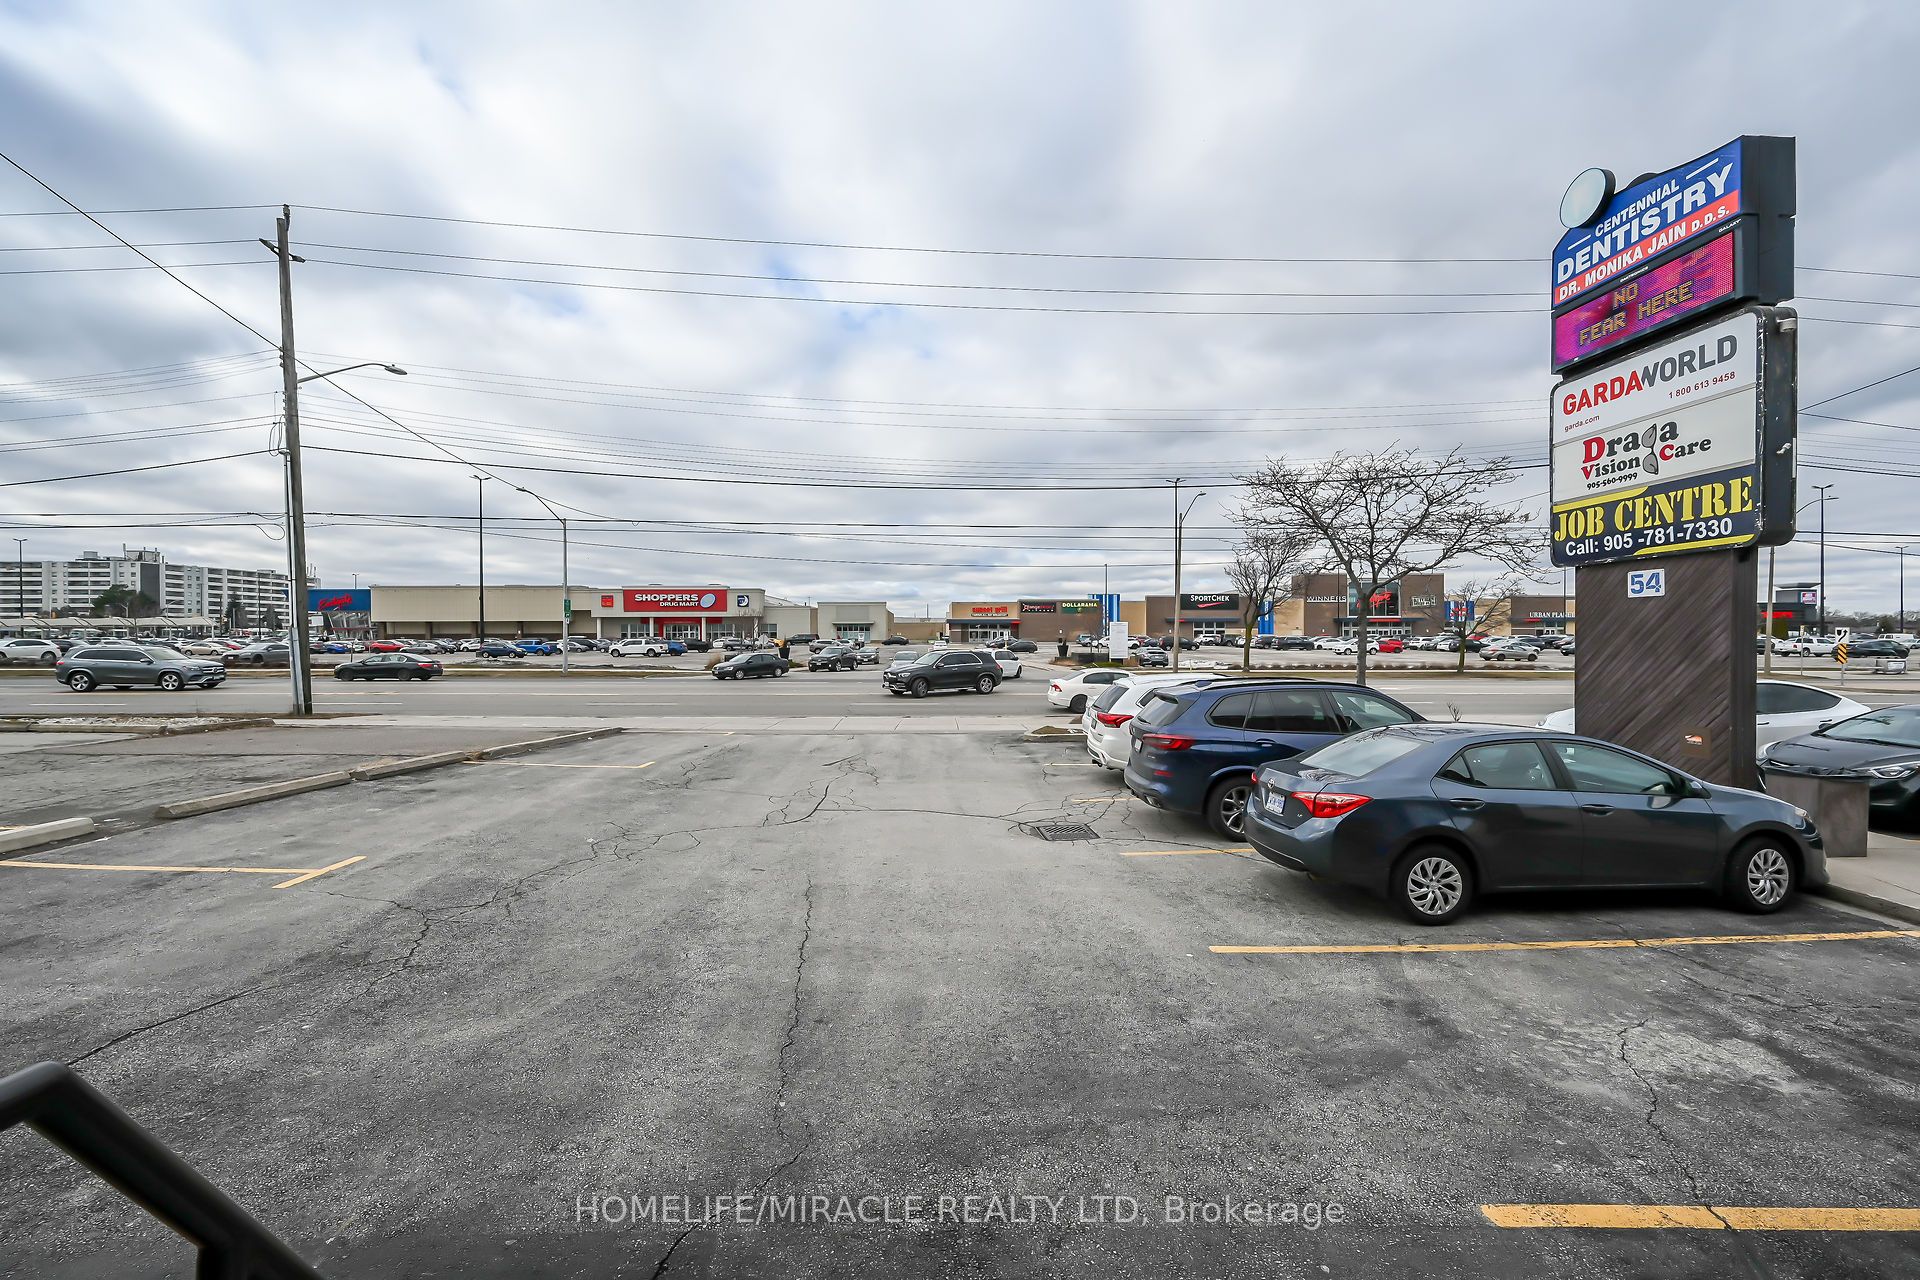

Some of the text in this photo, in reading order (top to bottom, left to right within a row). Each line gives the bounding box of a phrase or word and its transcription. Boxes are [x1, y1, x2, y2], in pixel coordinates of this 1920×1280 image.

[1557, 163, 1733, 284] DENTISTRY
[1595, 179, 1680, 237] CENTENNIAL
[1559, 280, 1580, 301] DR.
[1585, 247, 1643, 287] MONIKA
[1648, 224, 1687, 254] JAIN
[1579, 281, 1693, 346] FEAR HERE
[1613, 283, 1638, 309] NO
[1563, 334, 1737, 416] GARDAWORLD
[1668, 371, 1736, 399] 1 800 613 9458
[1564, 414, 1600, 432] garda.com
[1582, 436, 1712, 480] Vision Care
[1586, 472, 1638, 490] 905-560-9999
[1554, 476, 1753, 542] JOB CENTRE
[1565, 536, 1599, 556] Call:
[1603, 532, 1633, 551] 905
[634, 593, 699, 602] SHOPPERS
[1630, 572, 1661, 594] 54
